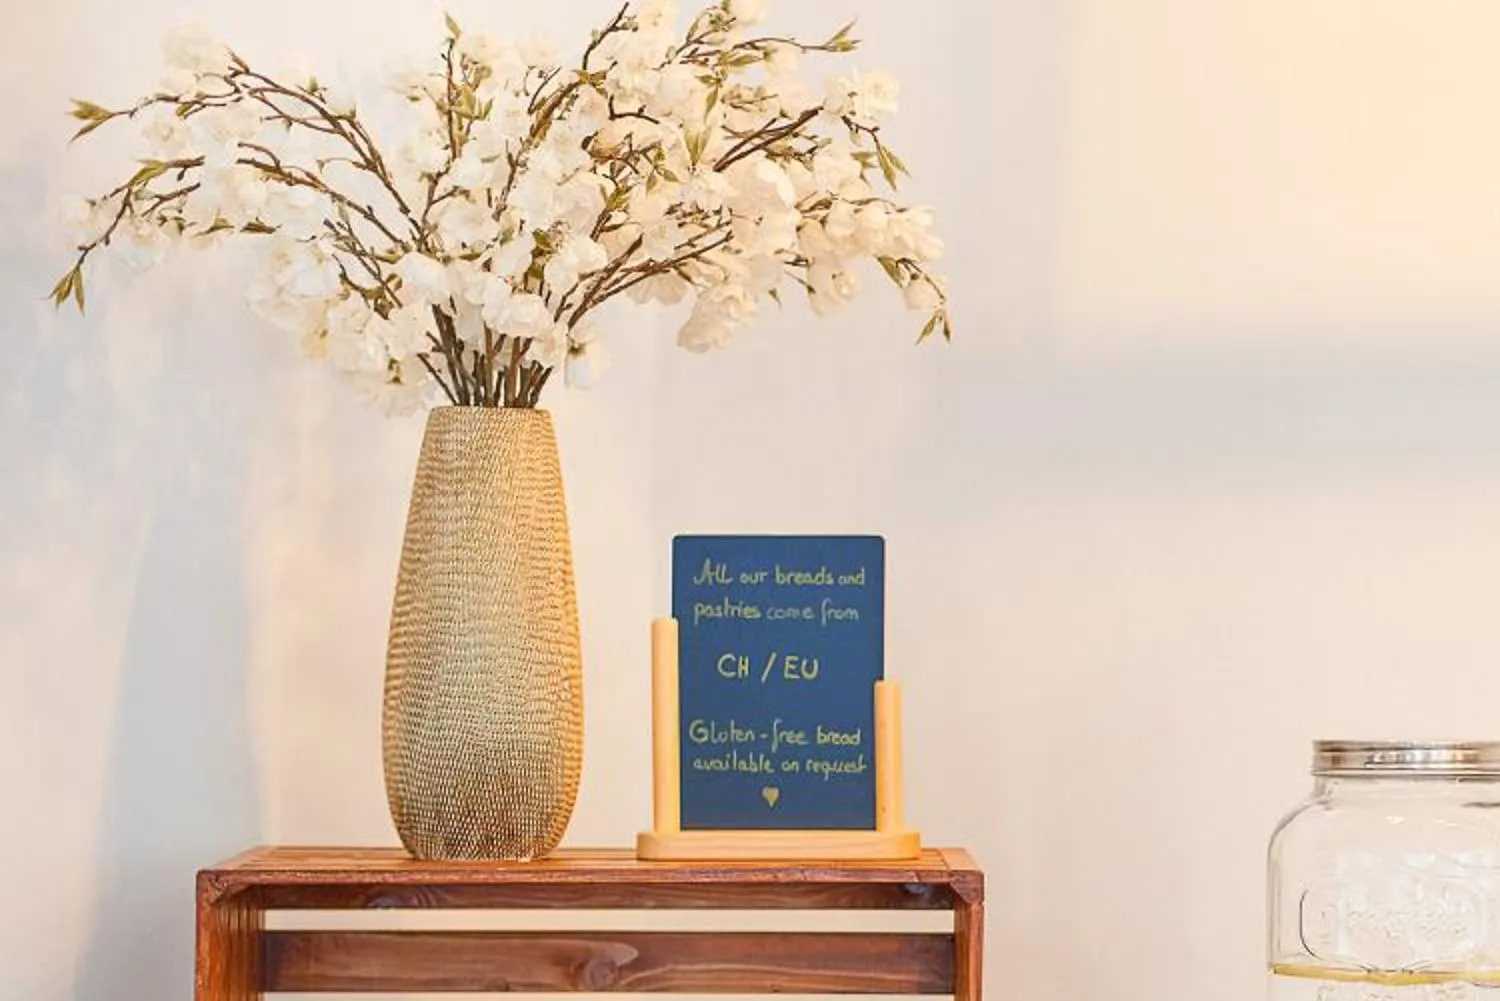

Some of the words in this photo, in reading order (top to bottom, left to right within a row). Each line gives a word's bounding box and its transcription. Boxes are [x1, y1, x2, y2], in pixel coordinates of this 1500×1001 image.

[693, 557, 734, 587] All
[740, 571, 768, 585] our
[775, 564, 834, 586] breads
[838, 567, 865, 586] and
[694, 597, 762, 627] pastries
[766, 604, 815, 620] come
[821, 599, 860, 627] from
[717, 653, 749, 679] CH
[761, 652, 777, 683] /
[784, 655, 819, 680] EU
[816, 725, 861, 746] bread
[693, 750, 776, 774] available
[781, 760, 800, 774] on
[805, 754, 868, 781] request
